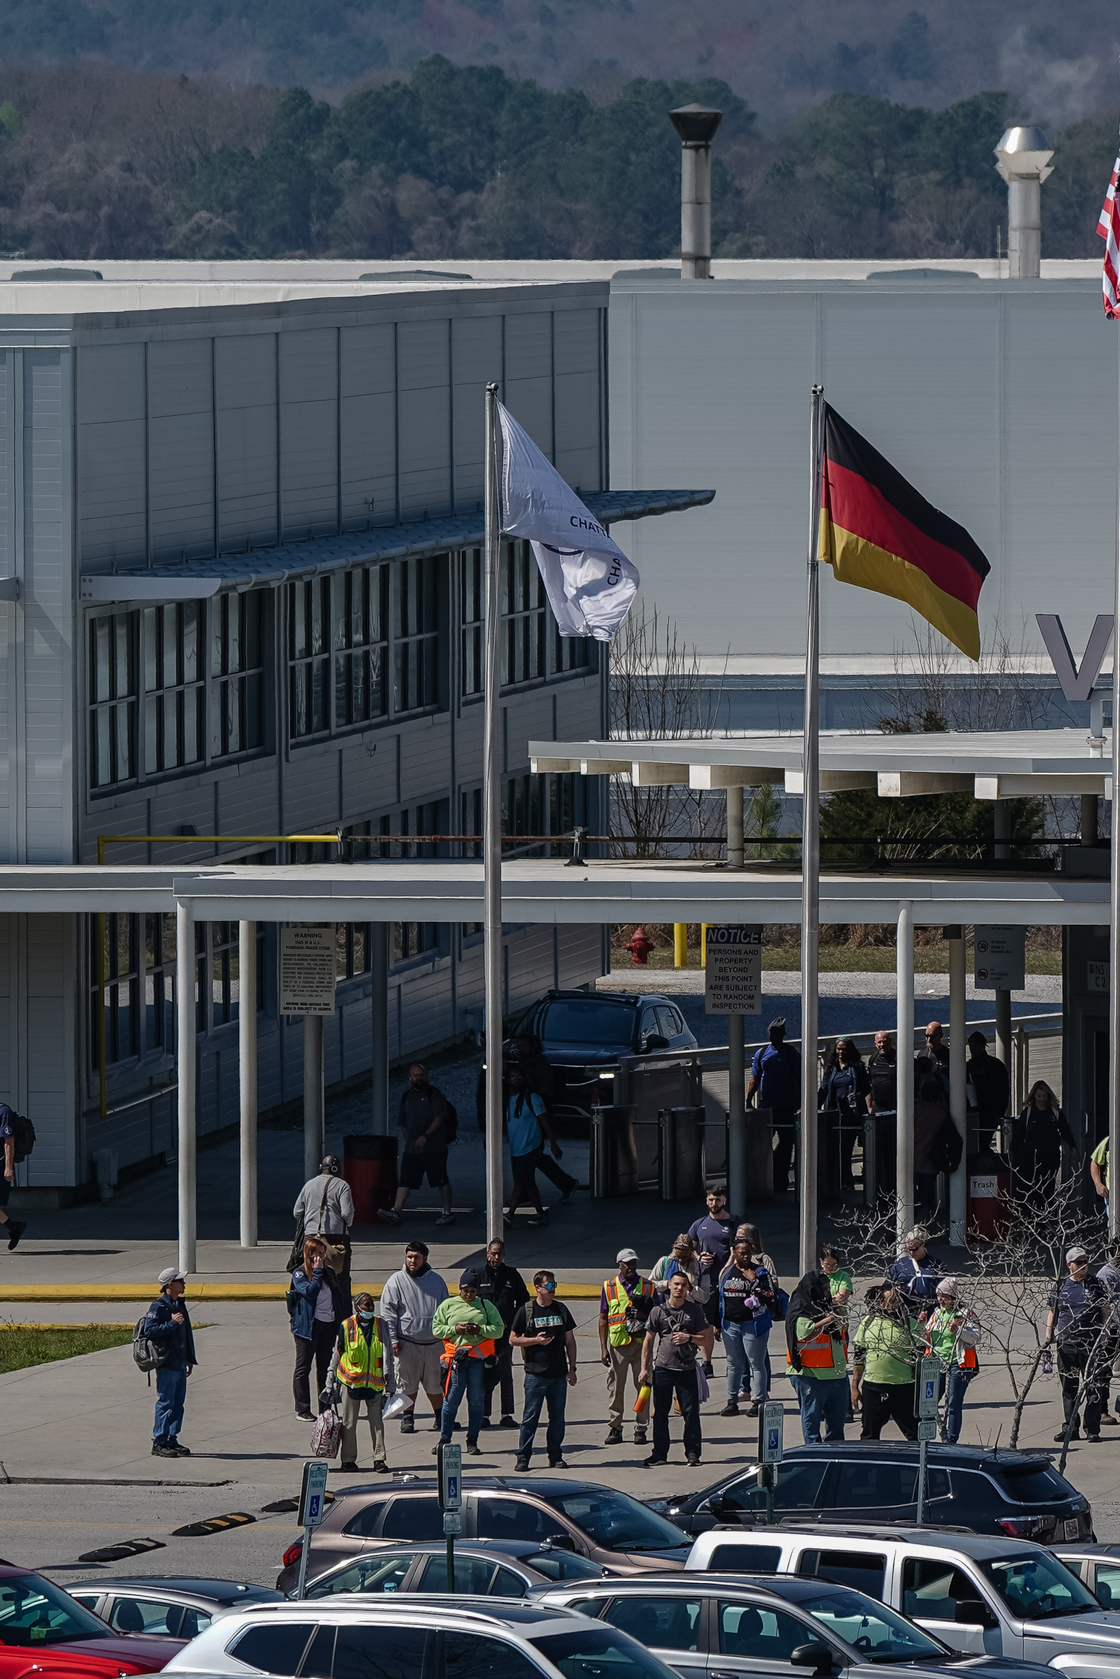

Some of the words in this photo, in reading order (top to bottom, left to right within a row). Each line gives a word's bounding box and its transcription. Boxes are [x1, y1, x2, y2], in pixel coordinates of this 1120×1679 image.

[708, 929, 759, 943] NOTICE
[708, 948, 742, 956] PERSONS
[714, 957, 753, 965] PROPERTY
[718, 966, 749, 974] BEYOND
[714, 975, 730, 983] THIS
[731, 975, 753, 983] POINT
[708, 984, 724, 992] ARE
[725, 984, 758, 992] SUBJECT
[712, 993, 722, 1001] TO
[723, 993, 755, 1001] RANDOM
[711, 1002, 755, 1010] INSPECTION
